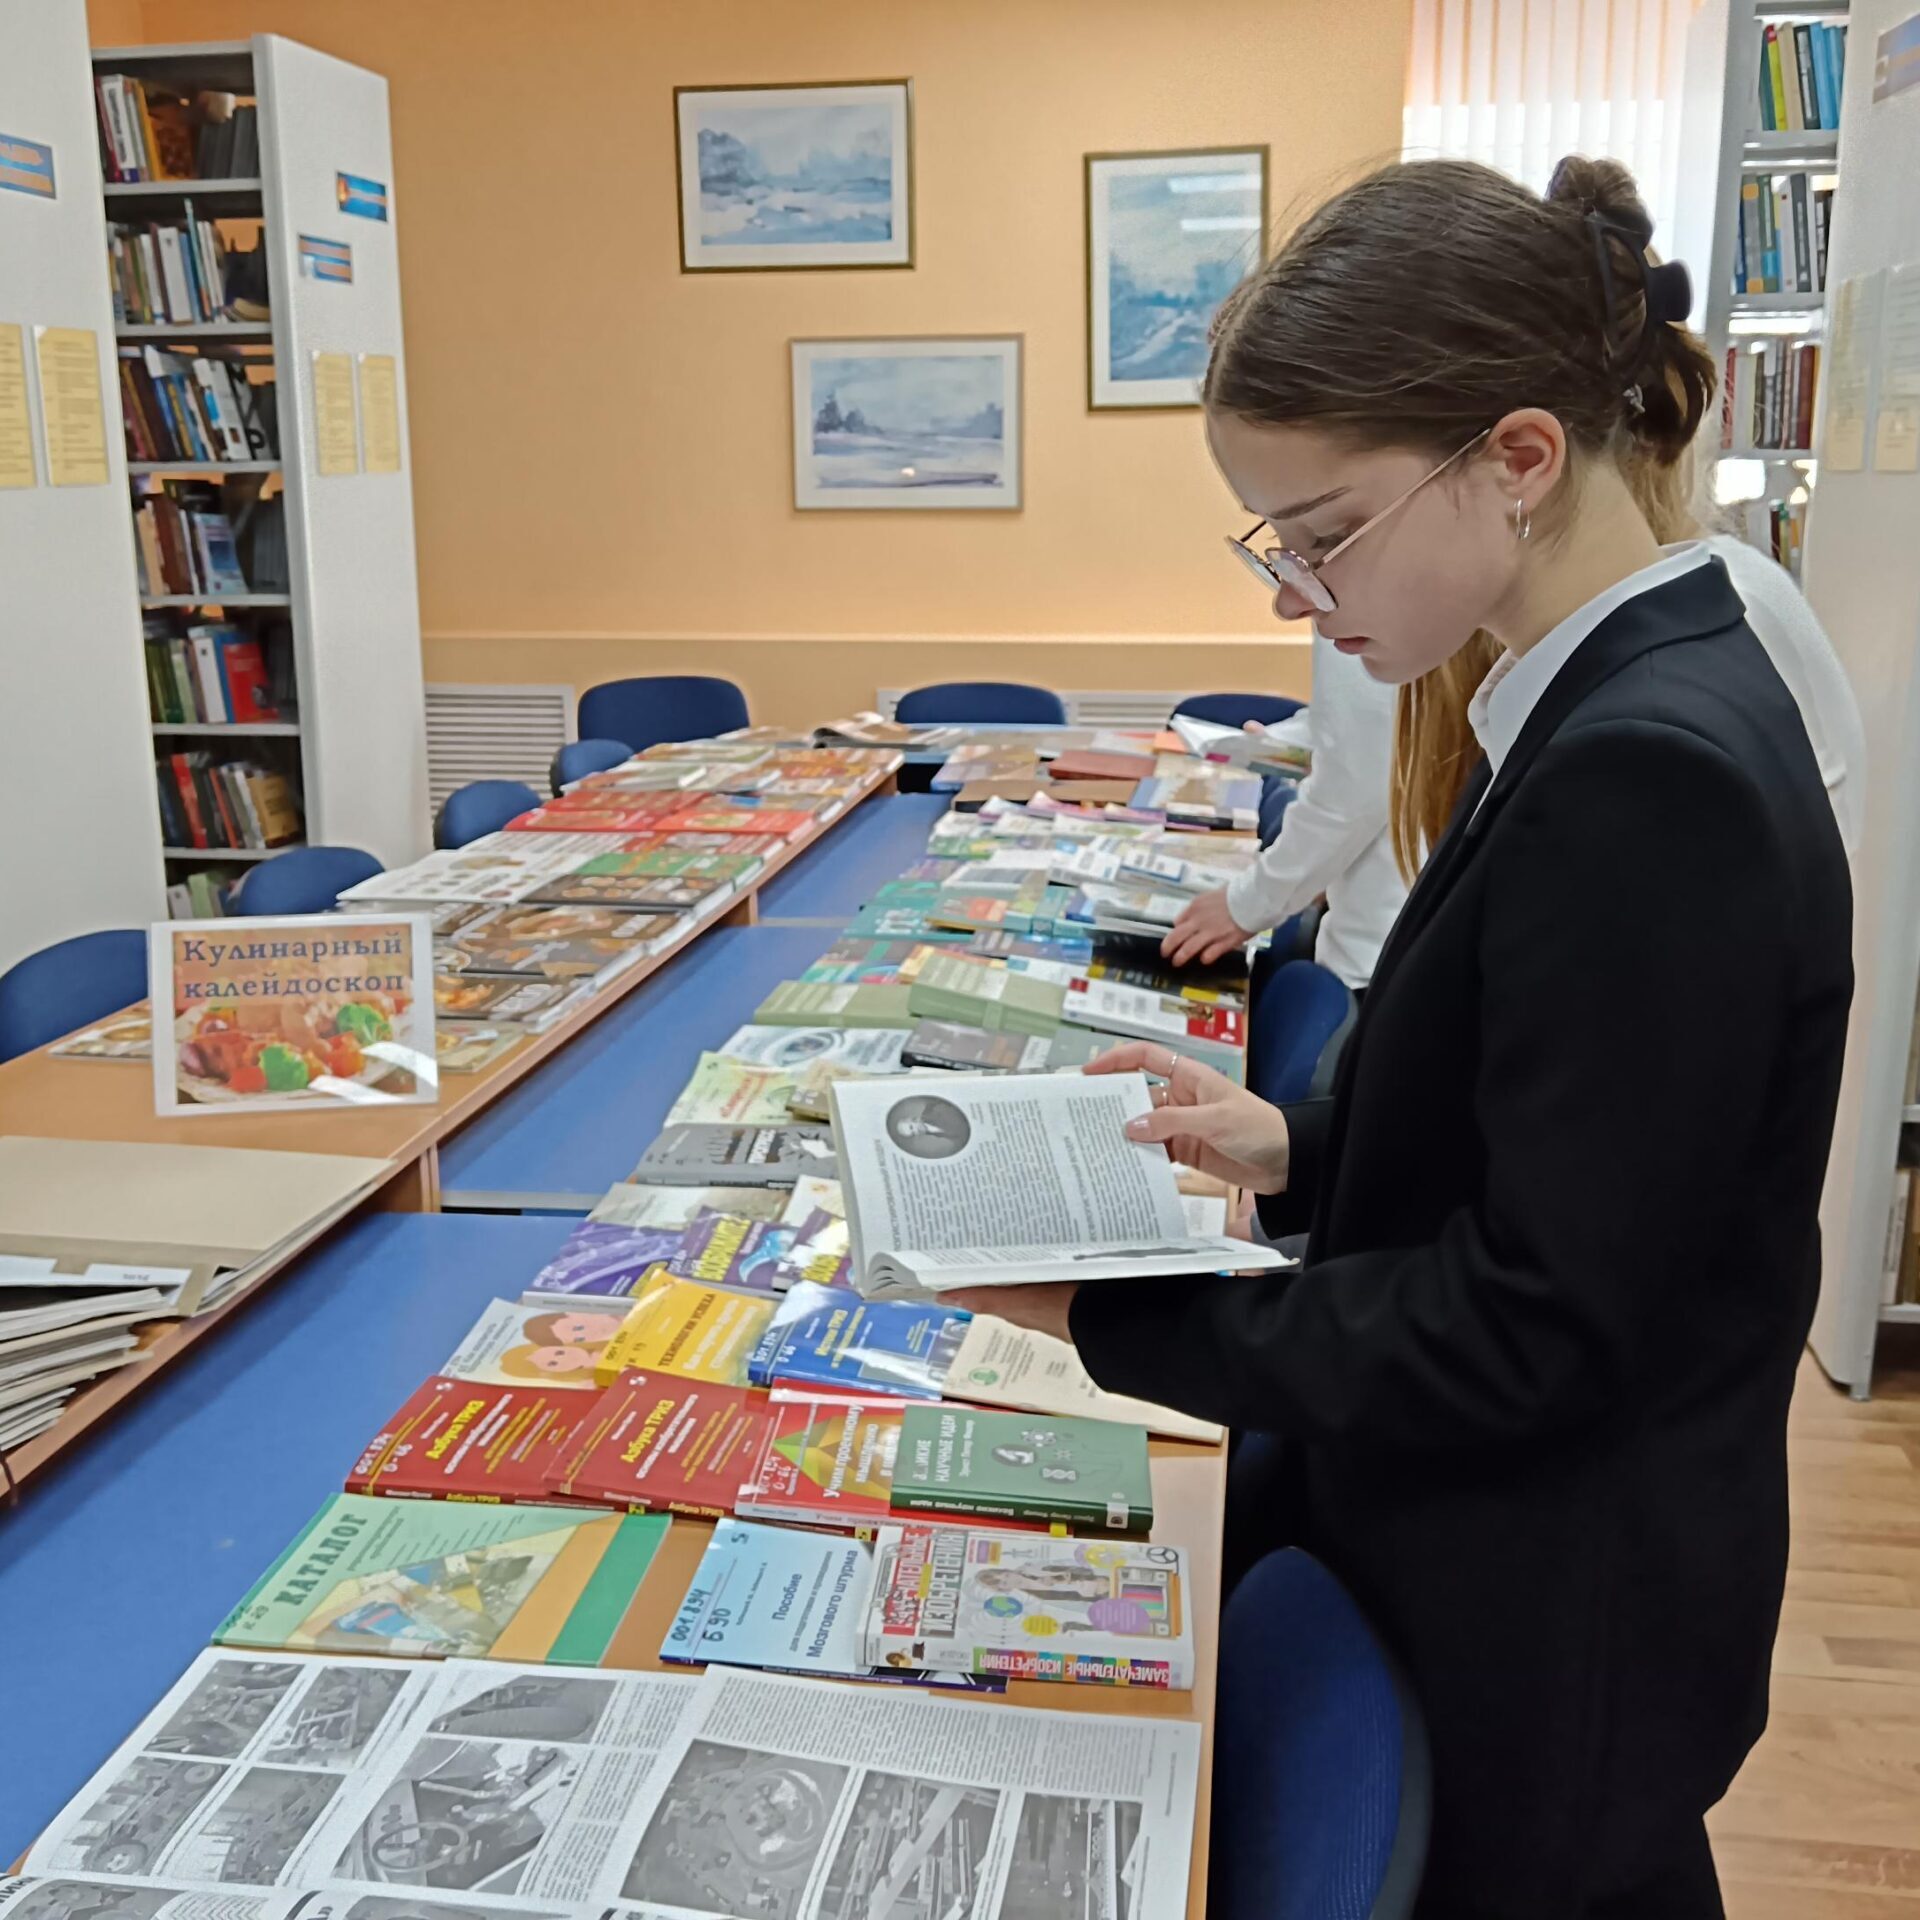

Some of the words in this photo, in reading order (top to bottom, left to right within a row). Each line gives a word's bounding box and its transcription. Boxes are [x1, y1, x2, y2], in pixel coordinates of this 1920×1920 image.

[183, 932, 403, 966] Кулинарный
[184, 972, 404, 998] калейдоскоп
[620, 1425, 656, 1463] Азбука
[644, 1400, 676, 1426] ТРИЗ
[823, 1467, 846, 1498] Учим
[837, 1404, 864, 1465] проектному
[940, 1414, 956, 1438] ИДЕИ
[856, 1424, 879, 1483] мышлению
[935, 1439, 954, 1482] НАУЧНЫЕ
[274, 1513, 368, 1606] КАТАЛОГ
[921, 1532, 966, 1632] ИЗОБРЕТЕНИЯ
[671, 1588, 711, 1641] 001.894
[772, 1573, 802, 1621] Пособие
[806, 1595, 841, 1658] Мозгового
[835, 1549, 858, 1594] штурма
[979, 1654, 1062, 1675] ИЗОБРЕТЕНИЯ
[1066, 1661, 1169, 1684] ЗАМЕЧАТЕЛЬНЫЕ
